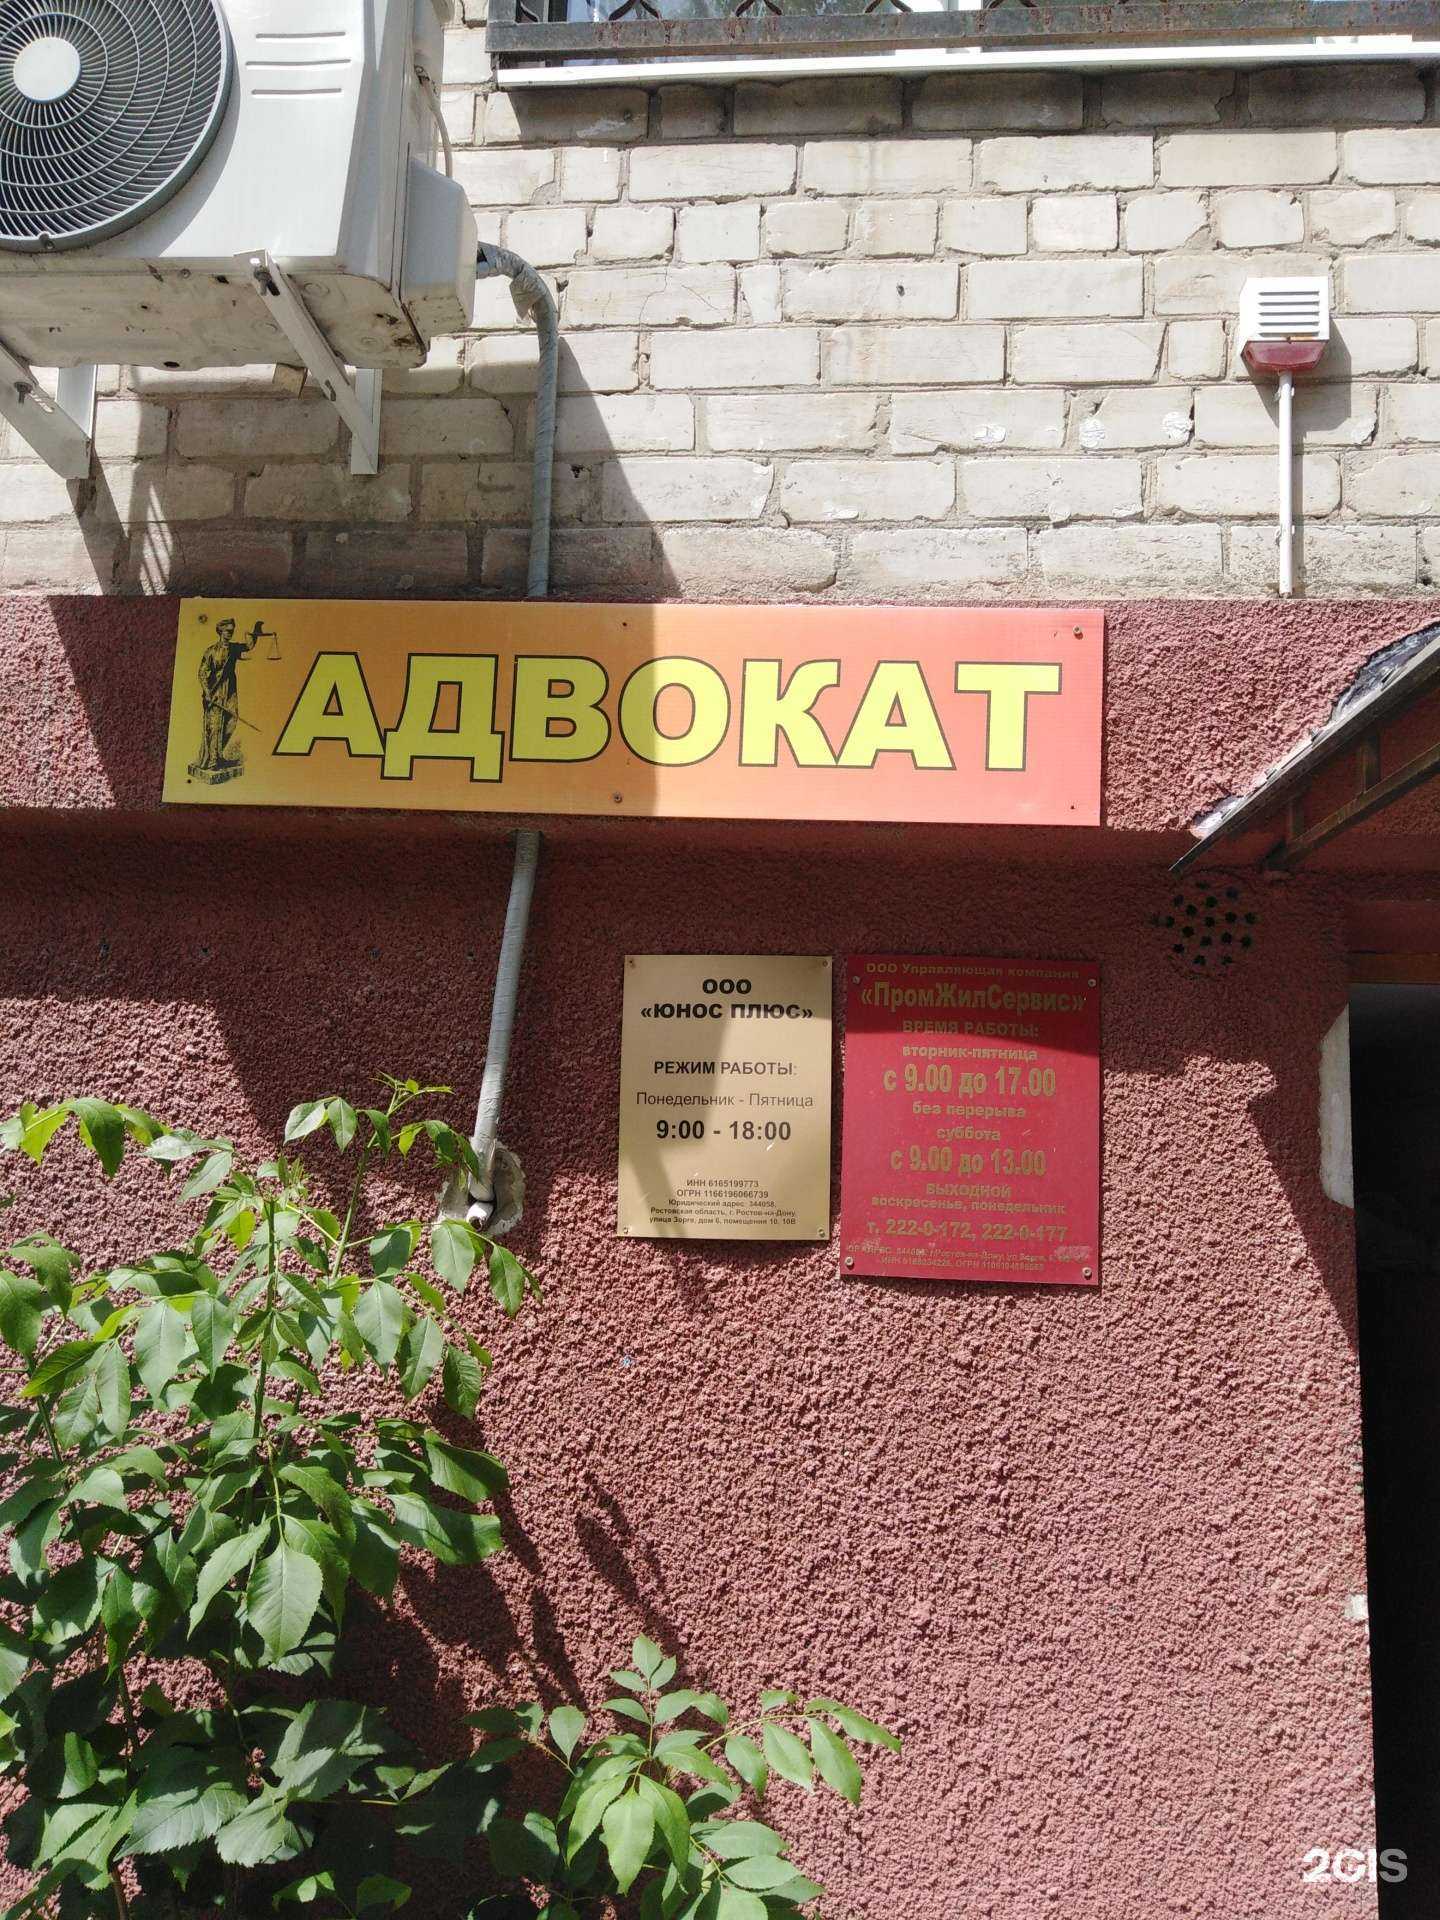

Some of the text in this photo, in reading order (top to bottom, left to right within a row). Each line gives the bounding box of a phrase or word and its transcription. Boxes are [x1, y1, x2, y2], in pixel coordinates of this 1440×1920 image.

[272, 651, 1063, 782] АДВОКАТ
[866, 962, 1080, 980] ООО Управляющая компания
[702, 978, 752, 994] ООО
[861, 981, 1086, 1016] «ПромЖилСервис»
[640, 1003, 814, 1020] «ЮНОС ПЛЮС»
[902, 1020, 1040, 1037] ВРЕМЯ РАБОТЫ:
[902, 1045, 1038, 1062] вторник-пятница
[653, 1060, 799, 1076] РЕЖИМ РАБОТЫ:
[903, 1063, 952, 1093] 9.00
[958, 1072, 987, 1098] до
[994, 1065, 1057, 1097] 17.00
[636, 1091, 735, 1107] Понедельник
[749, 1093, 814, 1109] Пятница
[911, 1099, 1026, 1120] без перерыва
[655, 1119, 705, 1140] 9:00
[729, 1121, 792, 1141] 18:00
[936, 1125, 1001, 1143] суббота
[909, 1145, 953, 1172] 9.00
[958, 1153, 985, 1177] до
[991, 1149, 1047, 1176] 13.00
[686, 1179, 706, 1188] ИНН
[676, 1189, 701, 1198] ОГРН
[971, 1201, 1067, 1216] понедельник
[649, 1216, 672, 1224] улица
